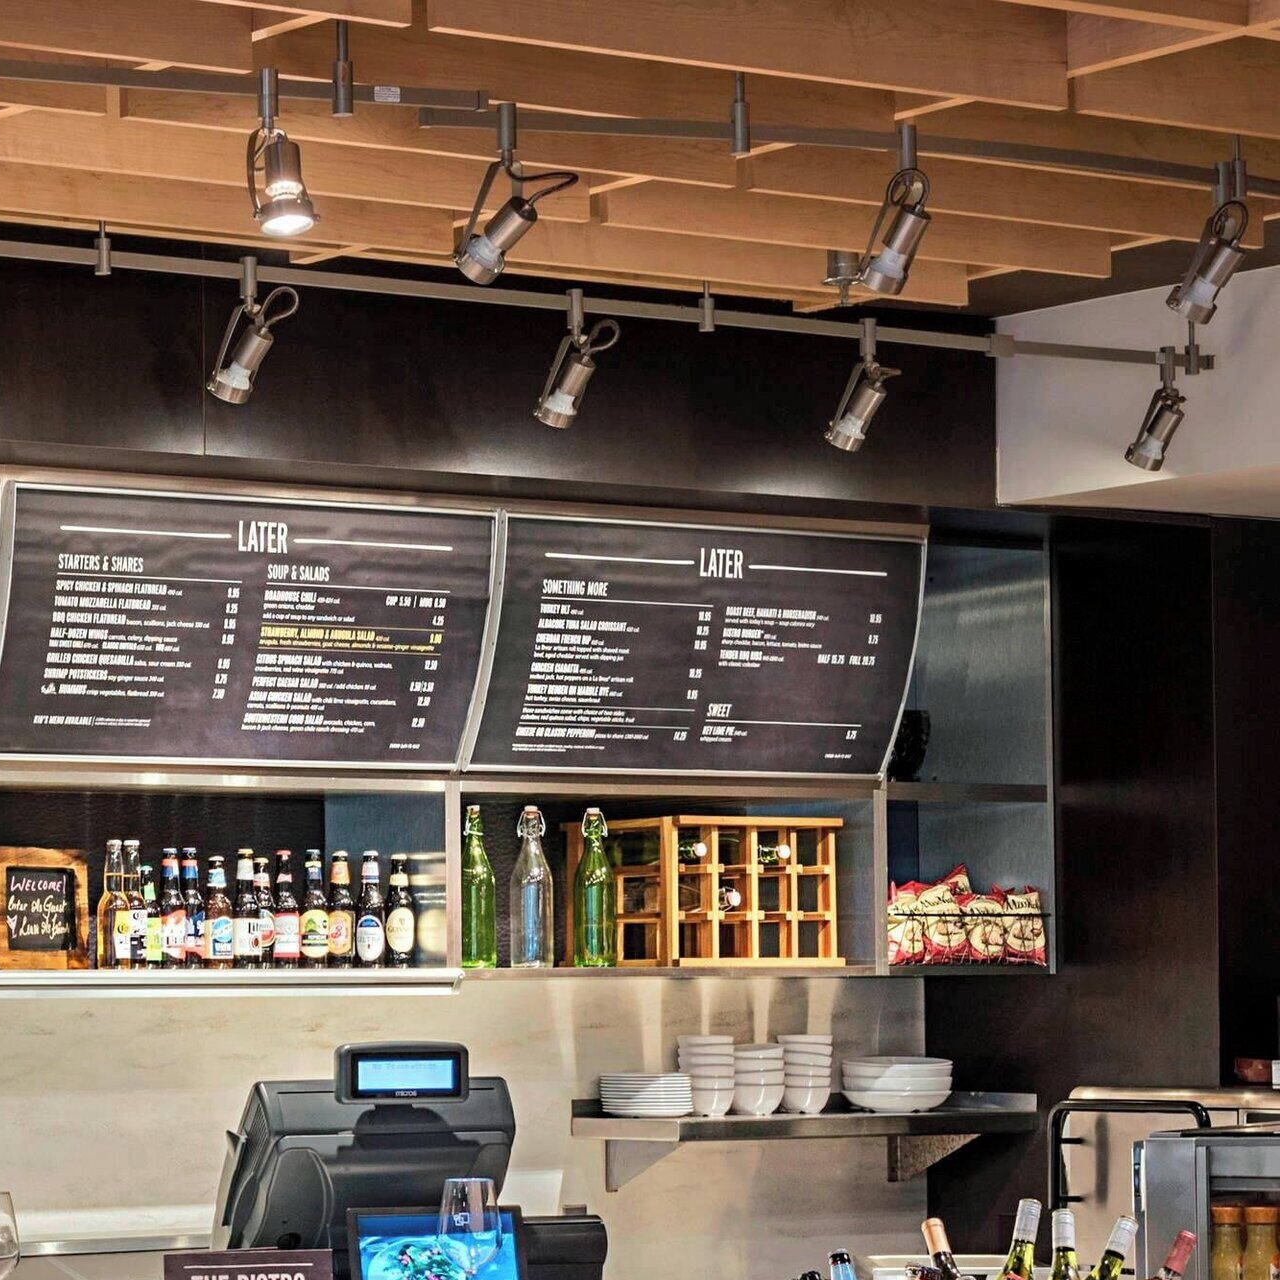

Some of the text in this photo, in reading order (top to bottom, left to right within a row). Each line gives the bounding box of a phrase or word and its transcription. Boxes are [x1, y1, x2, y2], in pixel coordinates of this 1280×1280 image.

[239, 521, 287, 553] LATER
[59, 554, 143, 572] STARTERS & SHARES
[700, 548, 743, 578] LATER
[268, 564, 329, 581] SOUP & SALADS
[543, 579, 608, 596] SOMETHING MORE
[707, 704, 731, 717] SWEET
